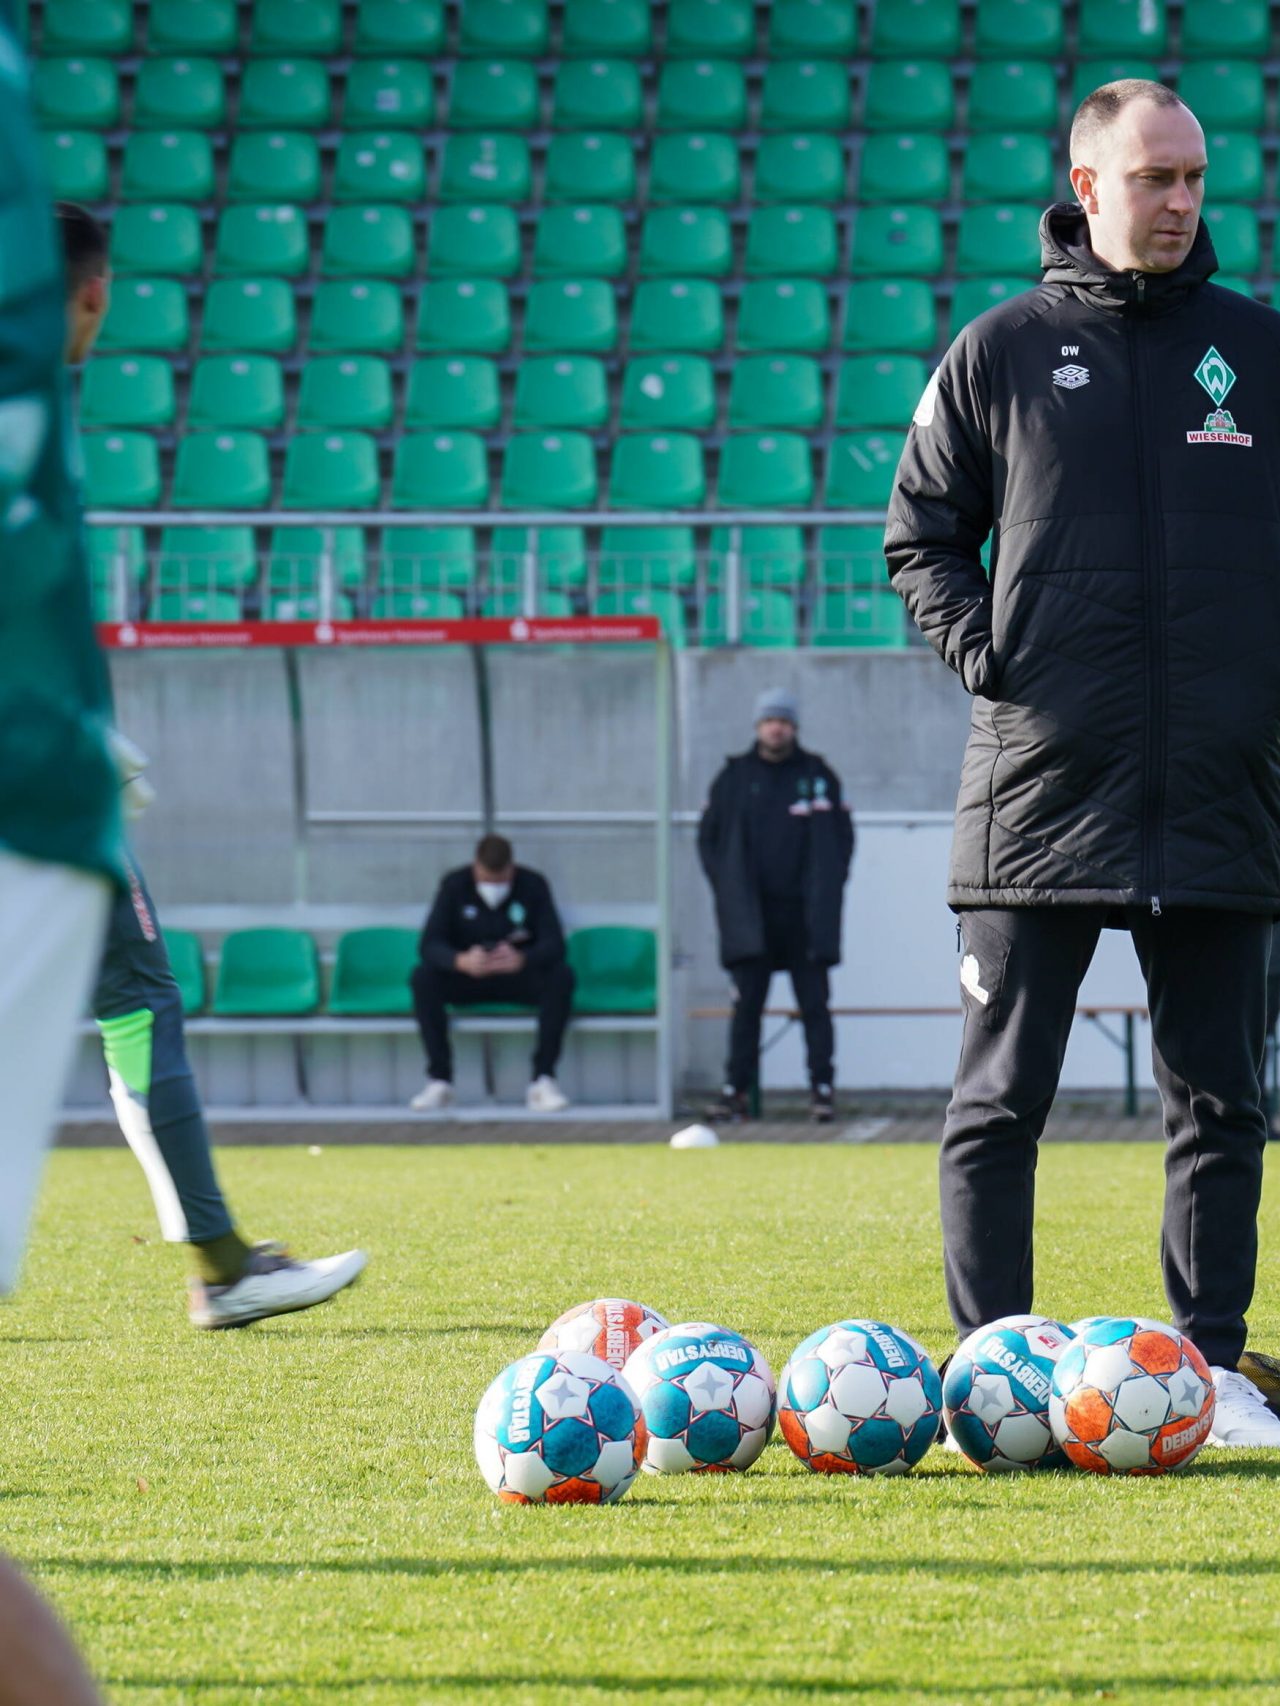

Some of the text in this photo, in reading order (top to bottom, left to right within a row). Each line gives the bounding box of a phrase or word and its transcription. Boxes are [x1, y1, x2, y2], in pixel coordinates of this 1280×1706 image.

[1061, 345, 1080, 356] OW
[1189, 432, 1251, 445] WIESENHOF
[655, 1344, 748, 1371] DERBYSTAR
